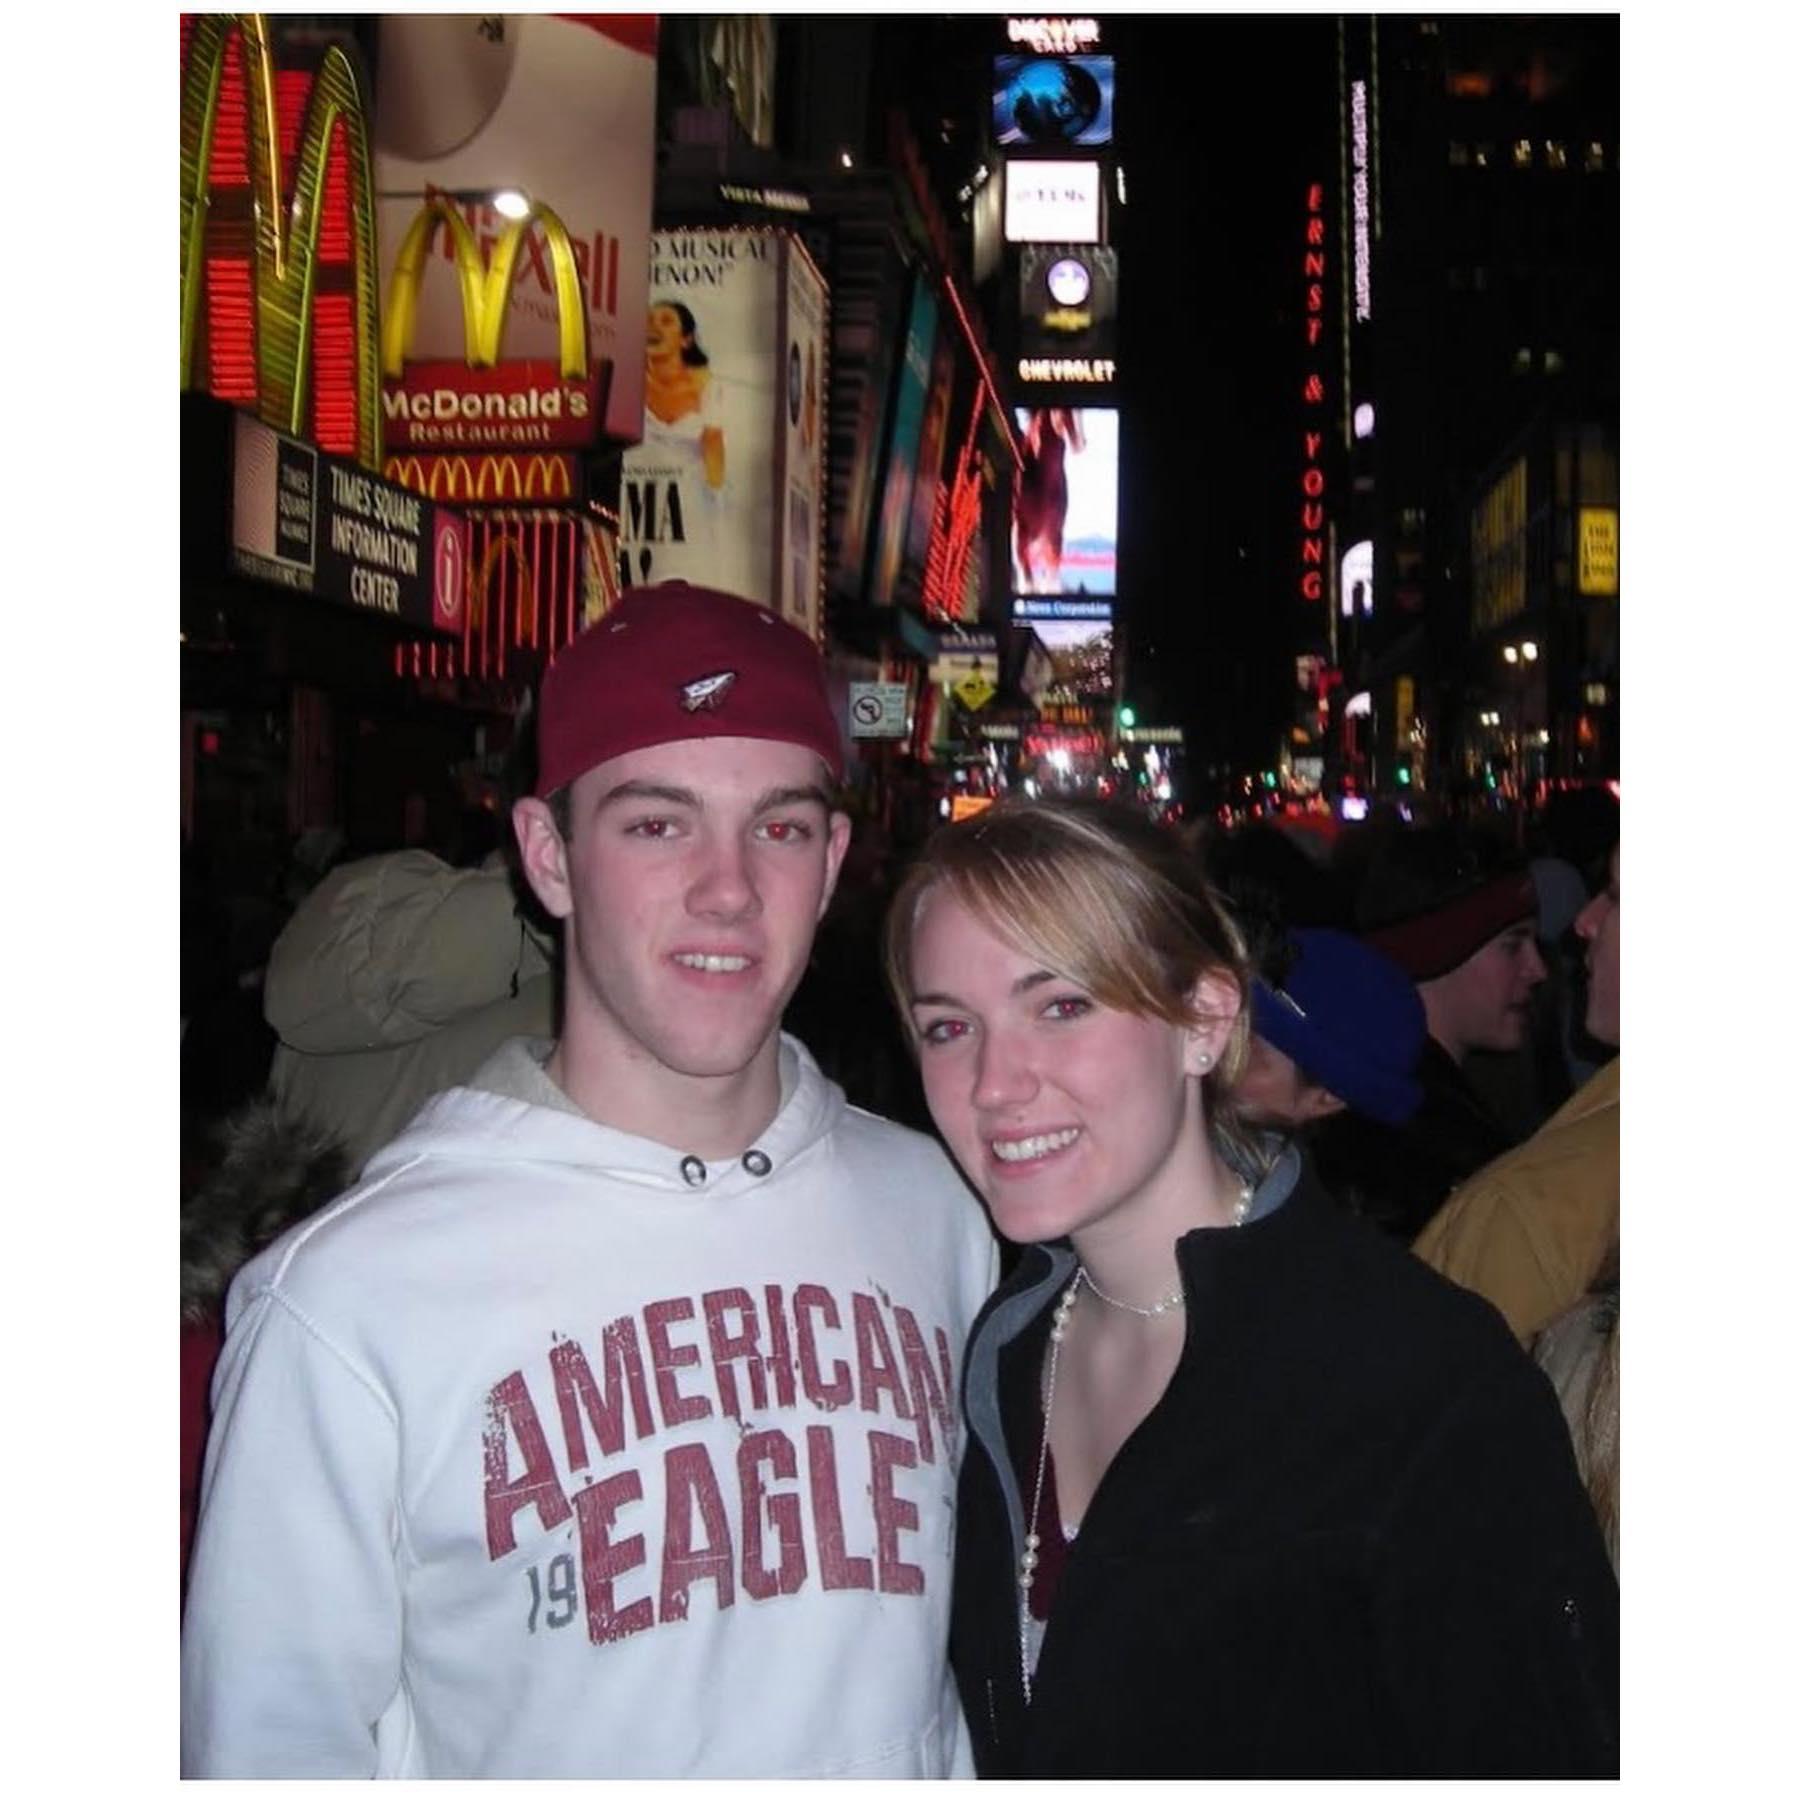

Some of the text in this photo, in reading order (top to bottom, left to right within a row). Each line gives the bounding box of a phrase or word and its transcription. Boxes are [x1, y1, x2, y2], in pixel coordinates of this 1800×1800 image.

[669, 238, 769, 260] MUSICAL
[383, 386, 588, 420] McDonald's
[1018, 359, 1117, 383] CHEVROLET
[1302, 183, 1325, 600] ERNST & YOUNG
[409, 421, 551, 443] Restaurant
[330, 464, 421, 537] TIMES SQUARE
[331, 512, 419, 578] INFORMATION
[350, 565, 401, 615] CENTER
[484, 1282, 958, 1562] AMERICAN
[571, 1424, 925, 1646] EAGLE
[525, 1552, 579, 1634] 19
